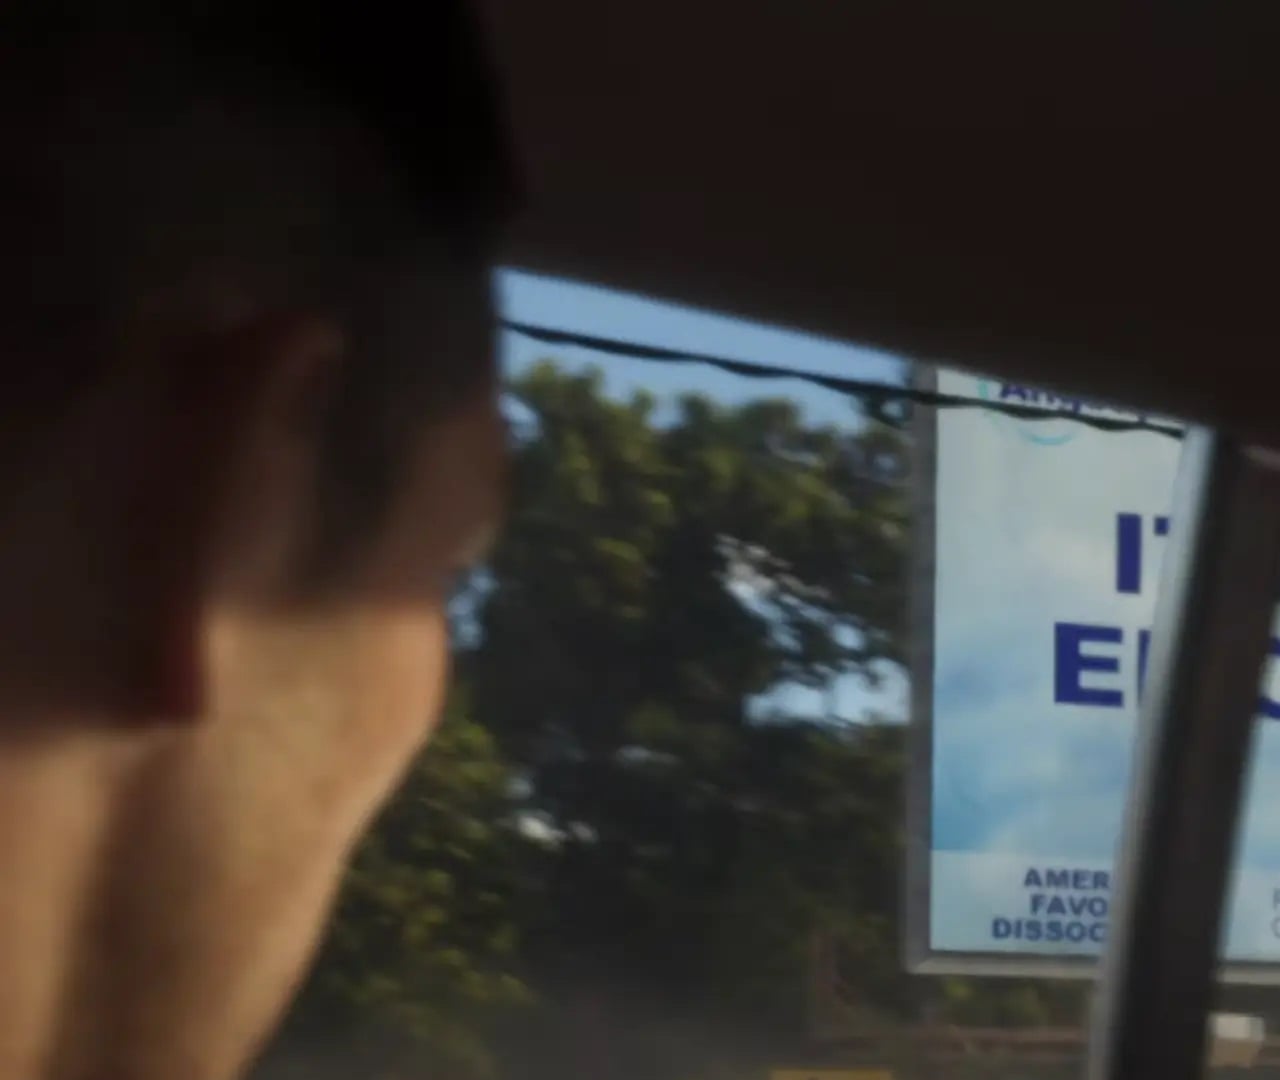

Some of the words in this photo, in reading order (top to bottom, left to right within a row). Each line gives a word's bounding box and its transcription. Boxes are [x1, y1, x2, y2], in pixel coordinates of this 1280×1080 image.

[1024, 867, 1110, 889] AMER
[1030, 893, 1108, 918] FAVO
[992, 917, 1106, 942] DISSOC
